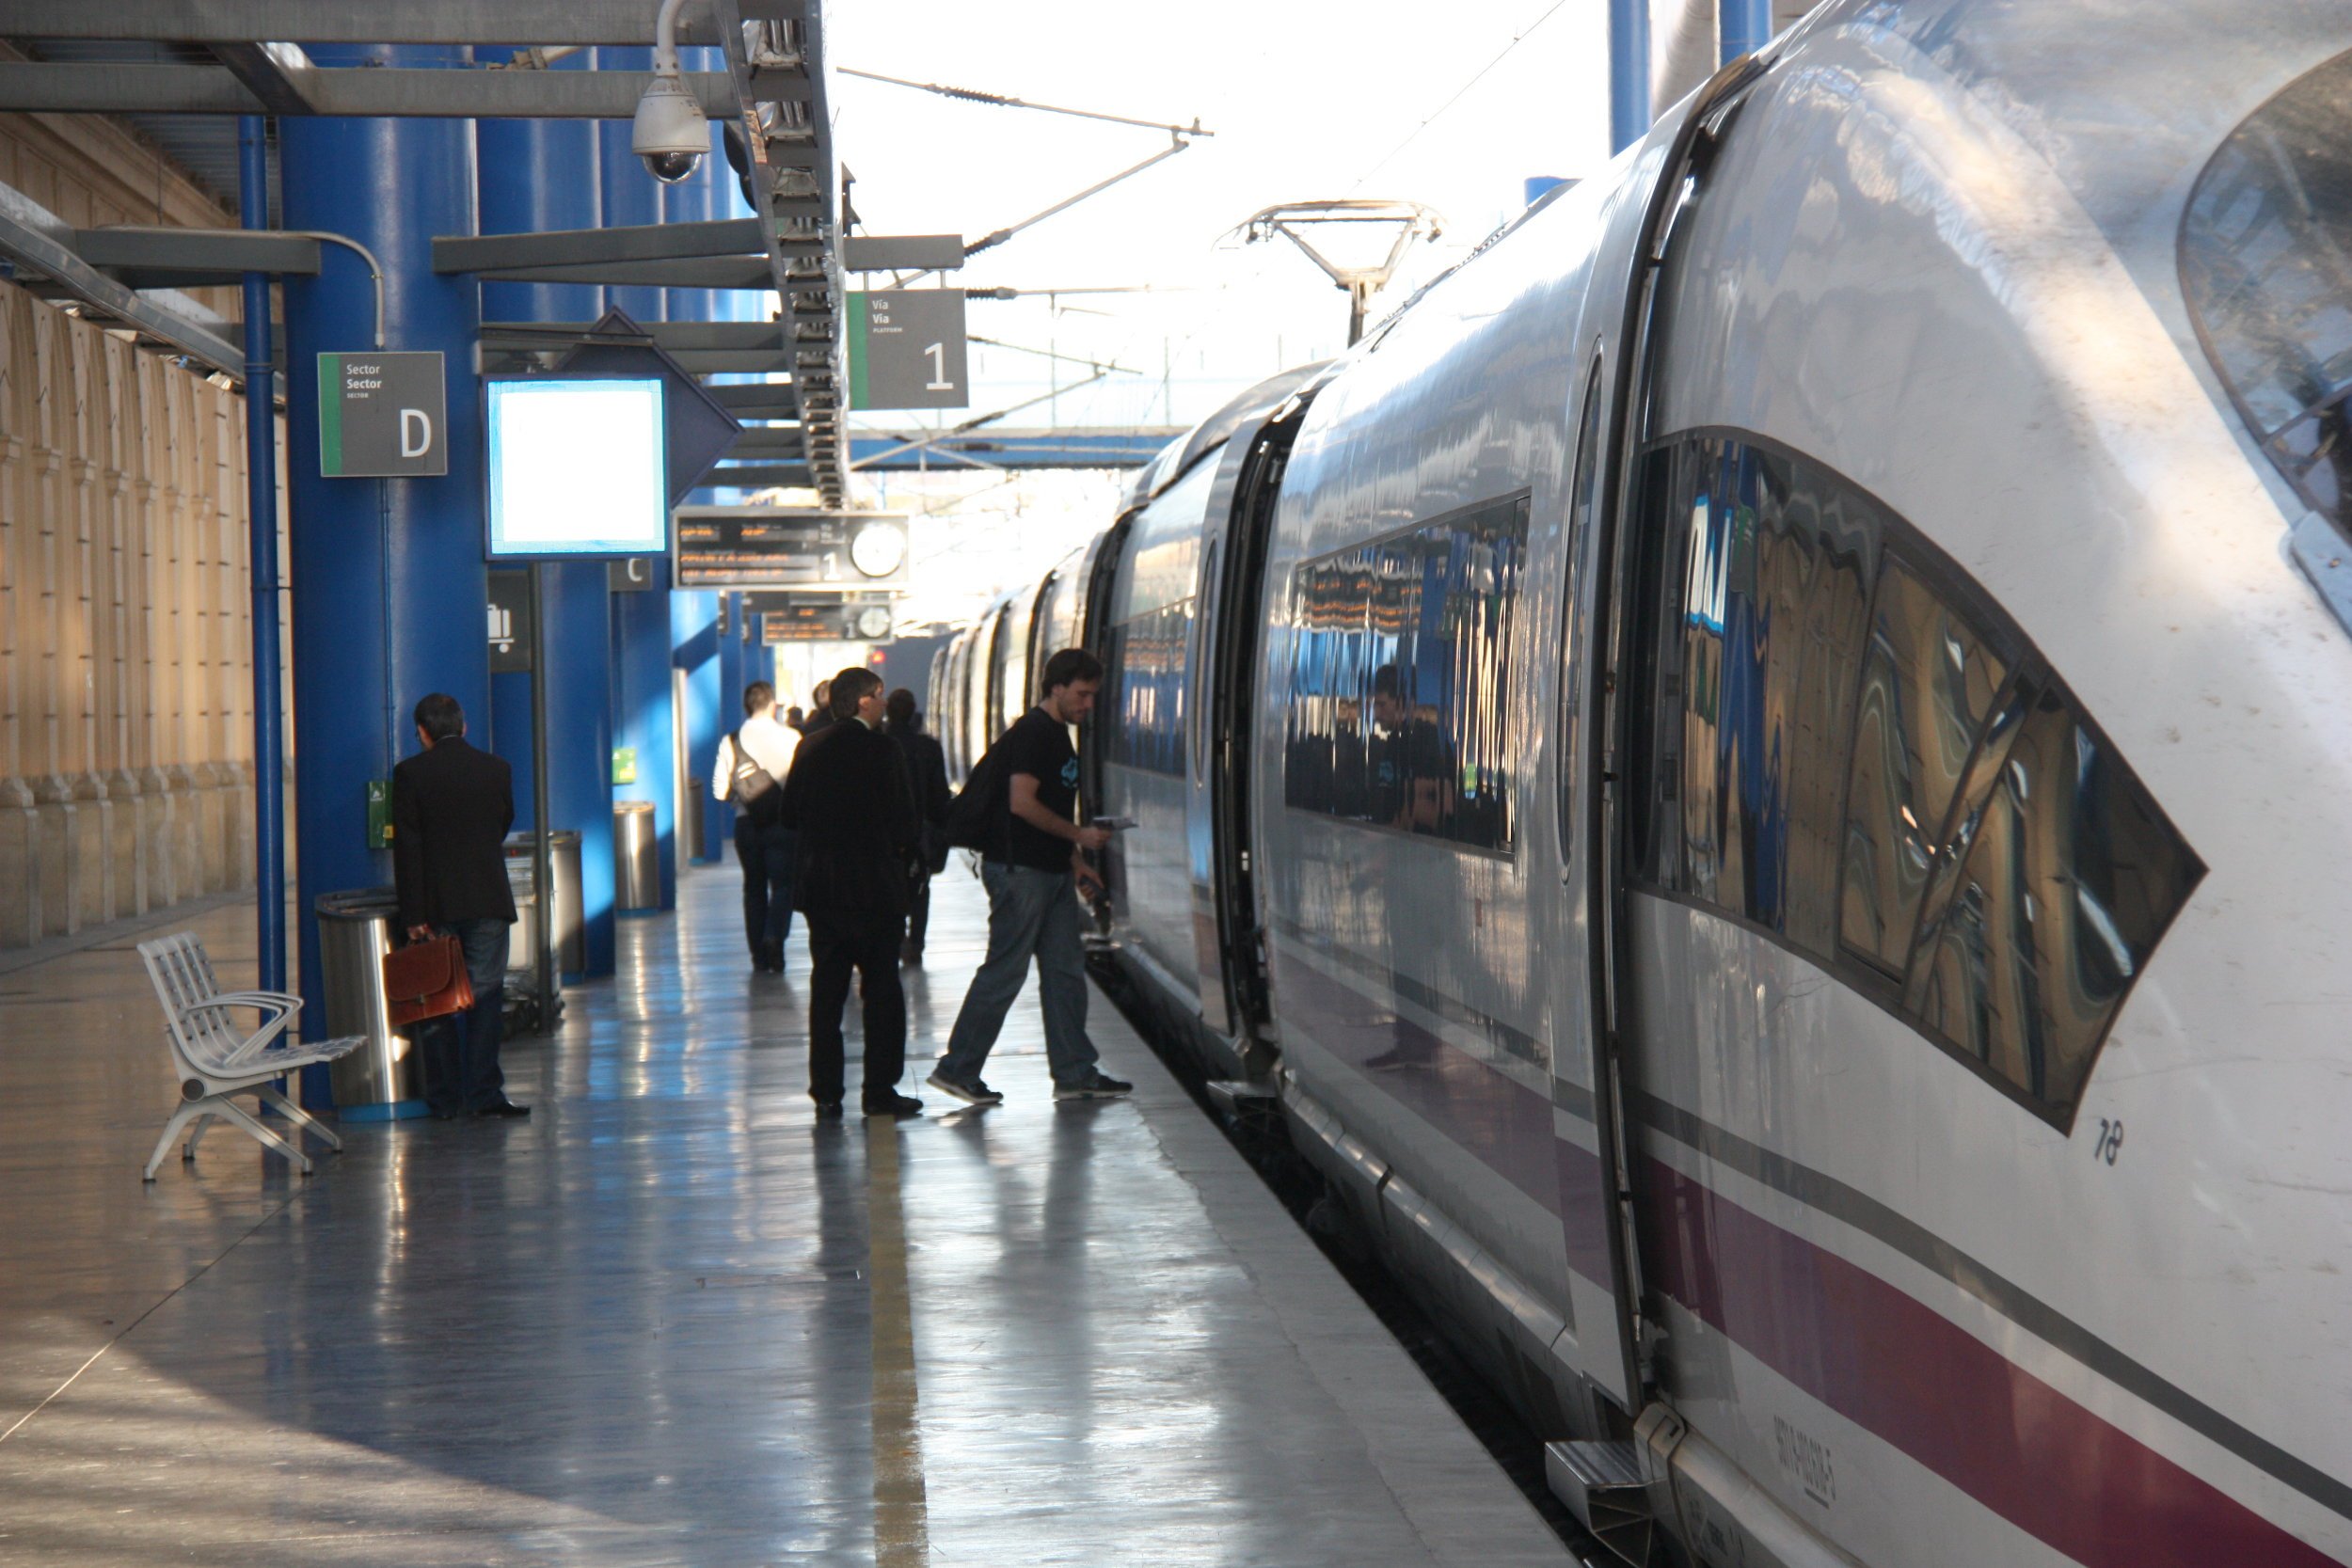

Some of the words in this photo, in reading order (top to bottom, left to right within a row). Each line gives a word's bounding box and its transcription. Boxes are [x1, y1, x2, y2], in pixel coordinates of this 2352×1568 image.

[346, 363, 381, 375] Sector
[925, 342, 954, 389] 1
[346, 378, 382, 389] Sector
[401, 408, 432, 458] D
[823, 551, 843, 581] 1
